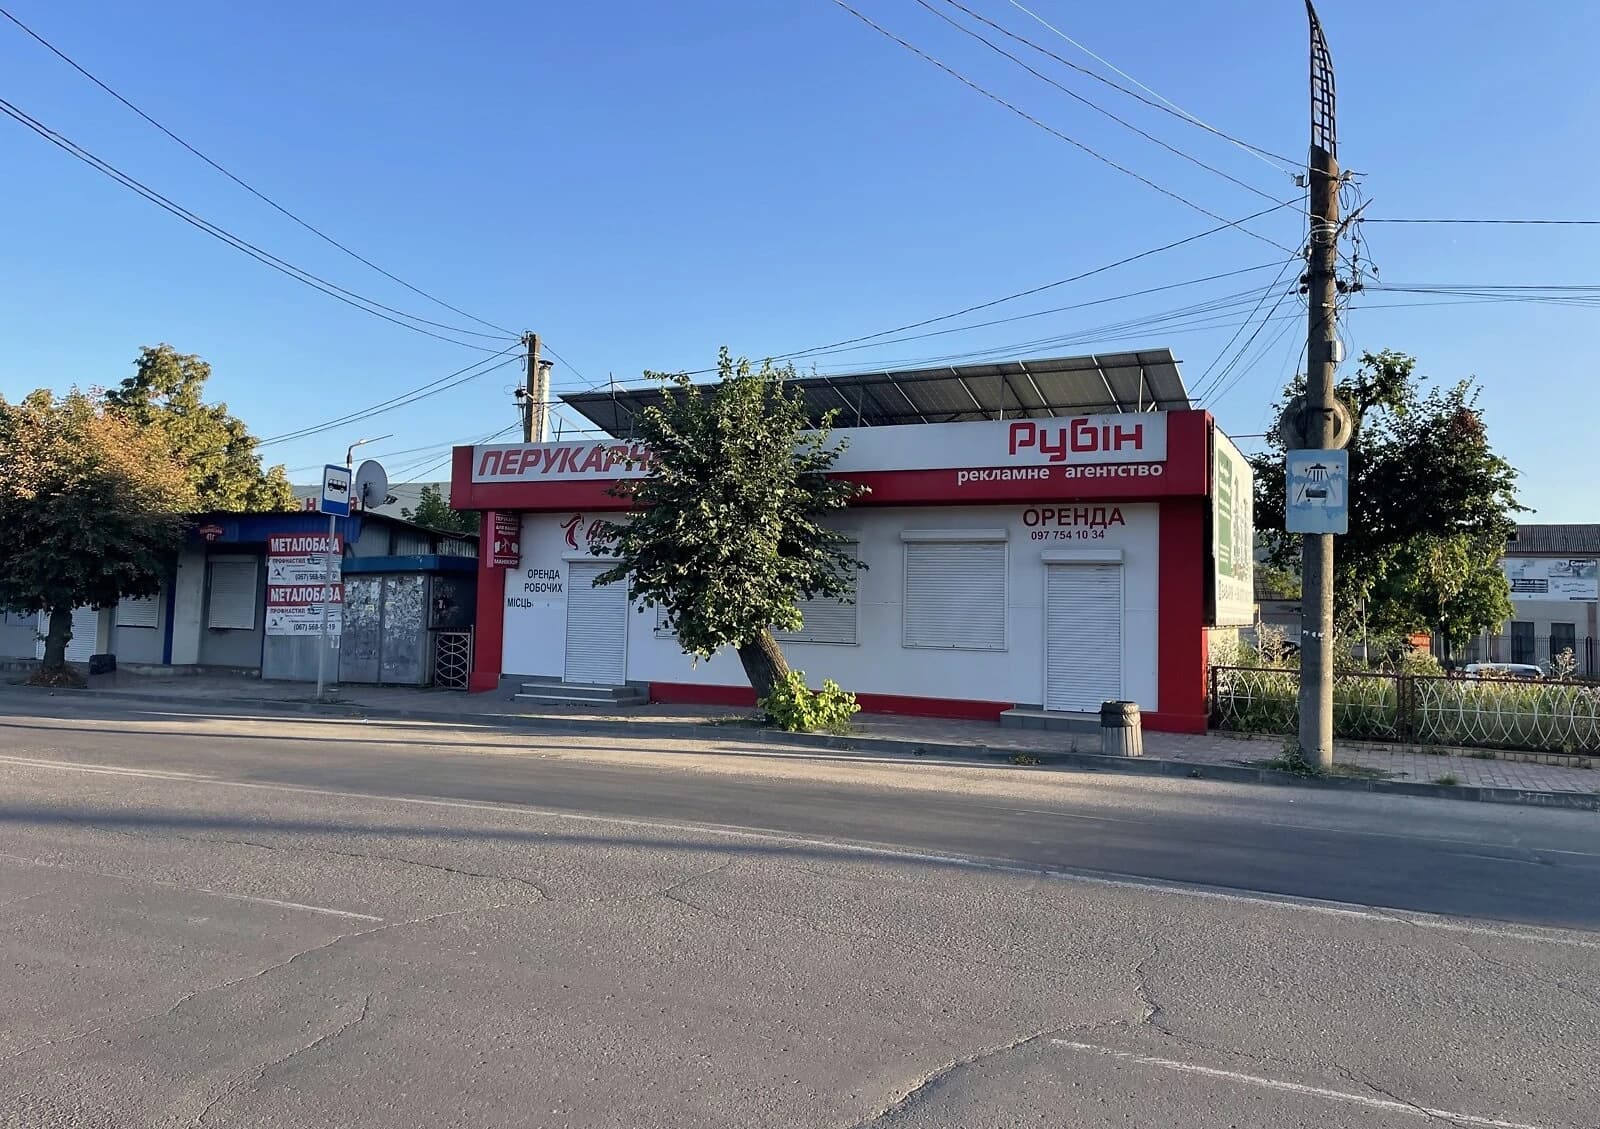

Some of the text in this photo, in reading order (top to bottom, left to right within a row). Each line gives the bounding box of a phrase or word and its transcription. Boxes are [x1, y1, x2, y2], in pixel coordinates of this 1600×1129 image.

[1009, 419, 1143, 462] Рубін
[478, 446, 661, 476] ПЕРУКАРН
[958, 464, 1163, 486] рекламне агентство
[1023, 508, 1126, 529] ОРЕНДА
[1031, 530, 1105, 540] 097 754 10 34
[527, 569, 560, 580] ОРЕНДА
[524, 583, 563, 593] РОБОЧИХ
[507, 598, 532, 608] МІСЦЬ
